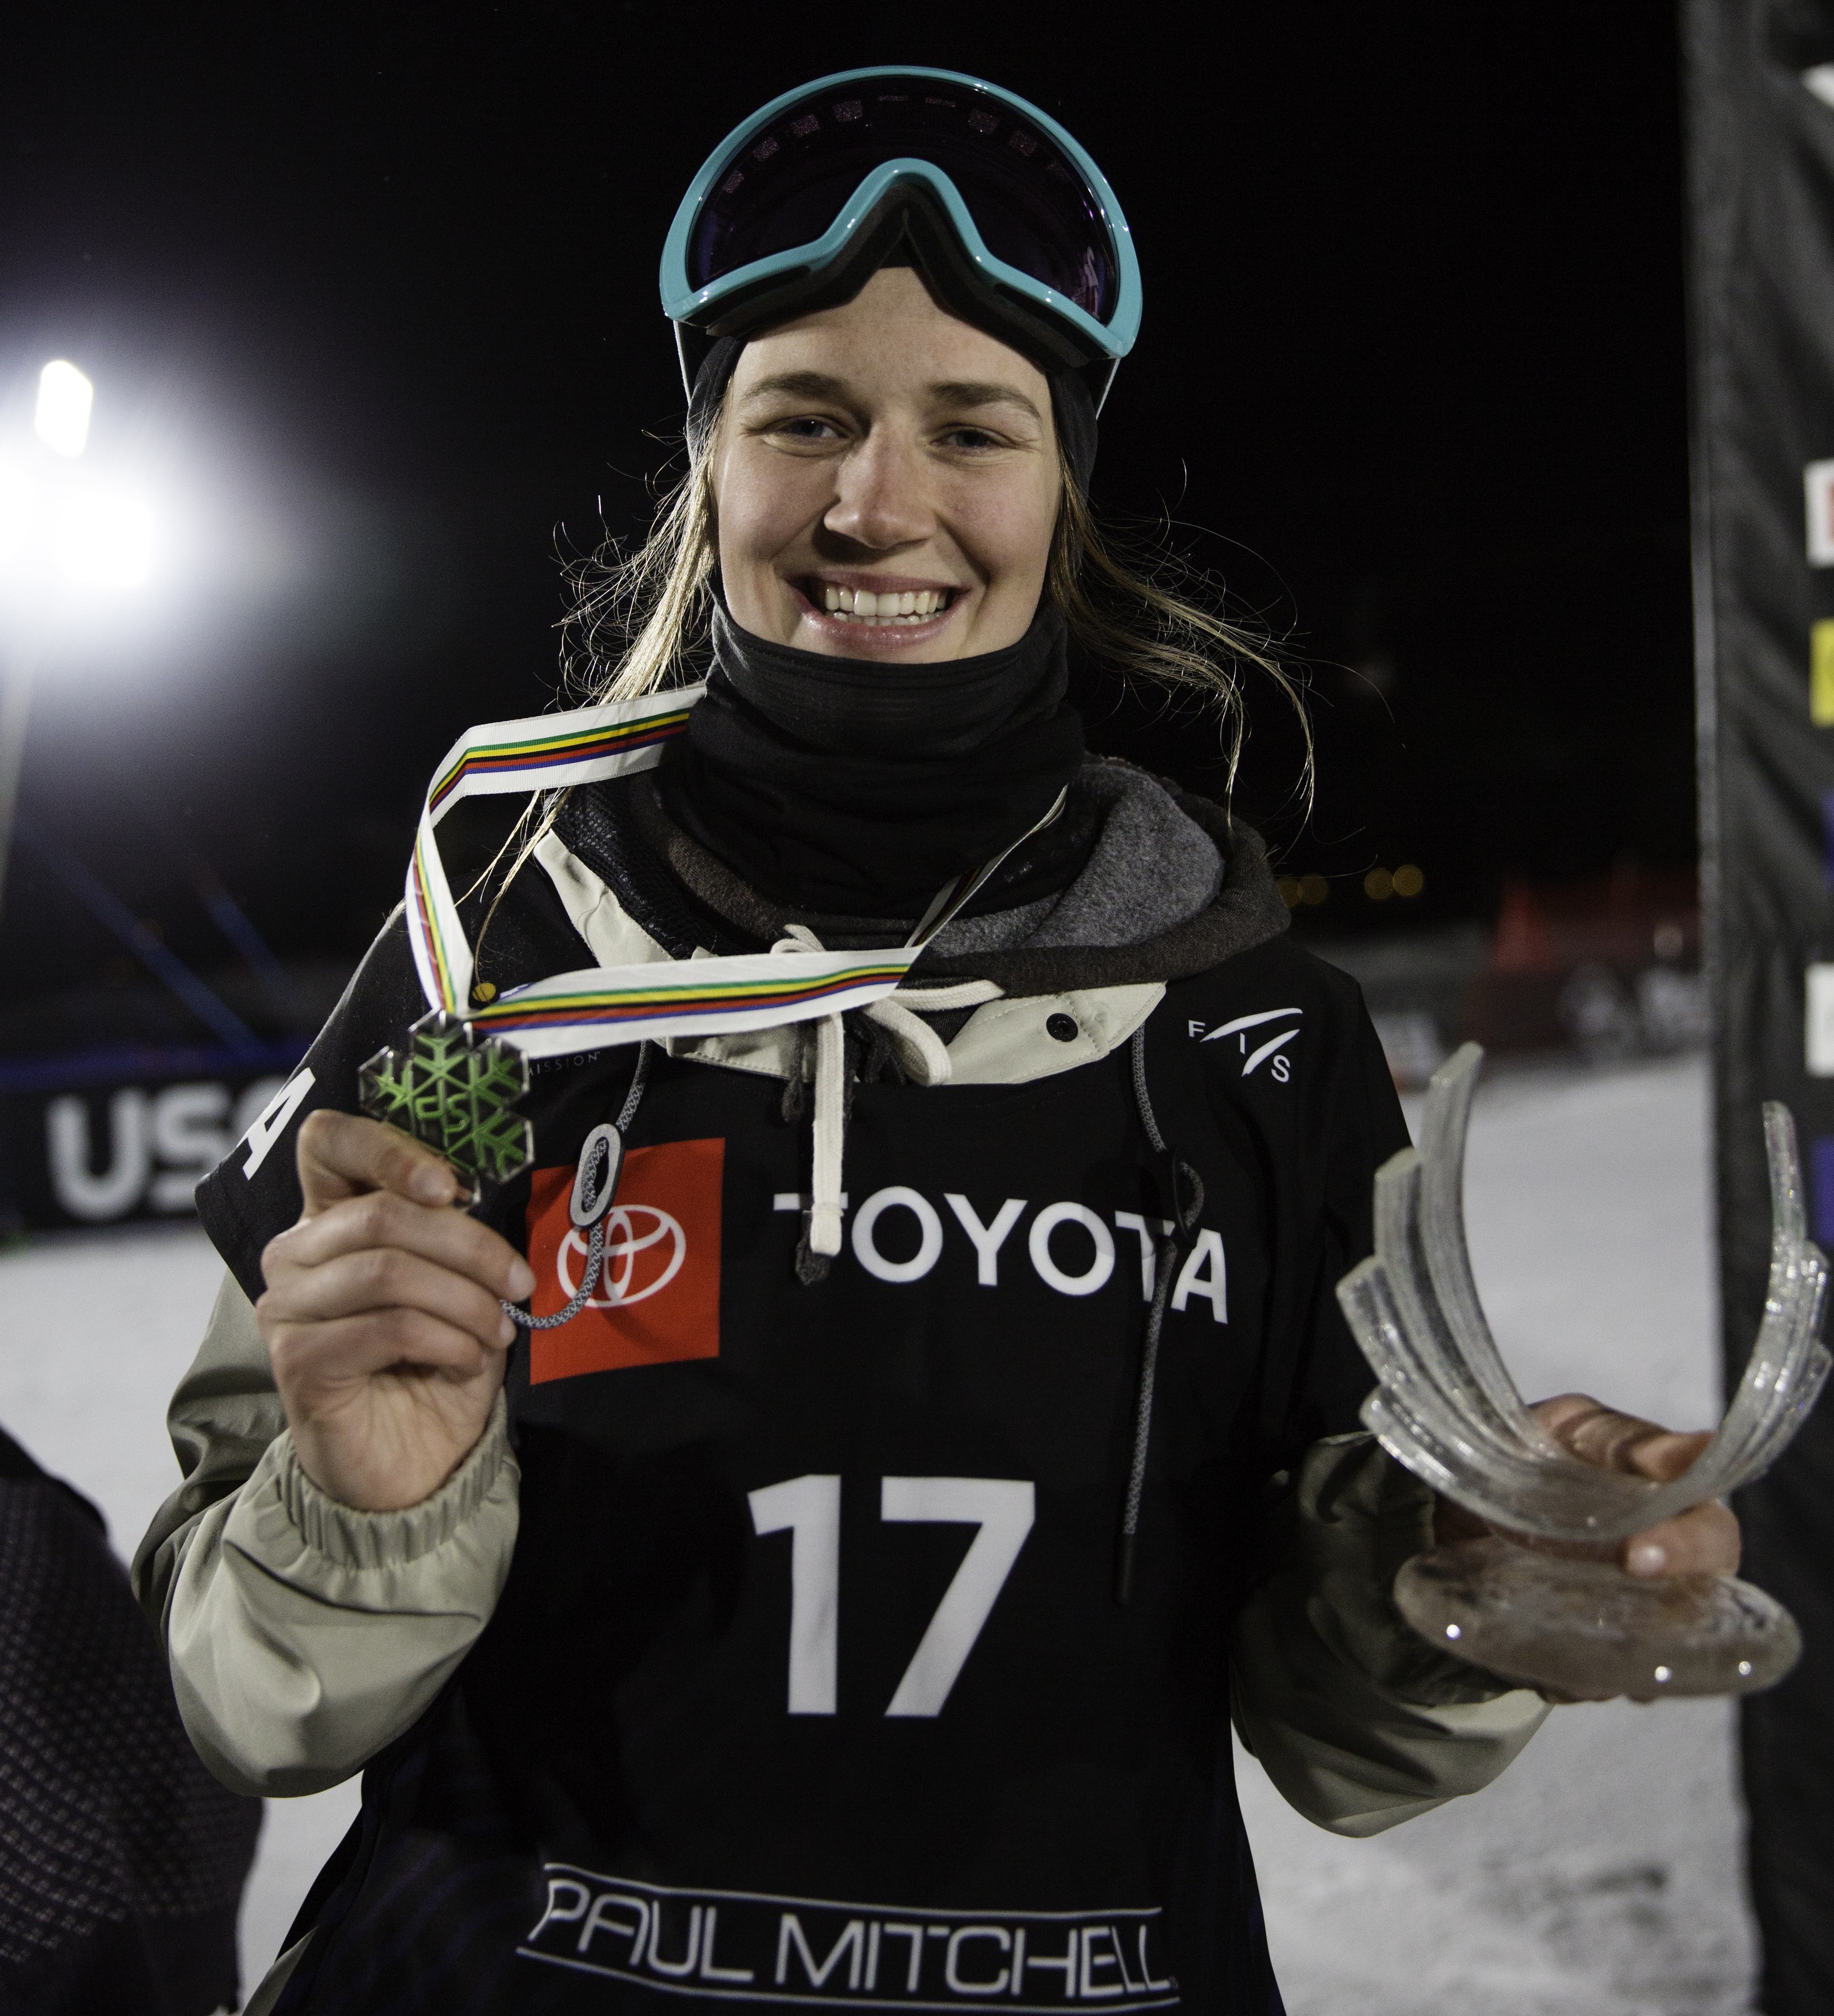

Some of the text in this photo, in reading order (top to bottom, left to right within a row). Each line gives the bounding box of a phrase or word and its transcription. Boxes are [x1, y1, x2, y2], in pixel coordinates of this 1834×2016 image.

[1187, 1018, 1291, 1083] FIS
[747, 1474, 1036, 1718] 17
[528, 1878, 1171, 1997] PAUL MITCHELL
